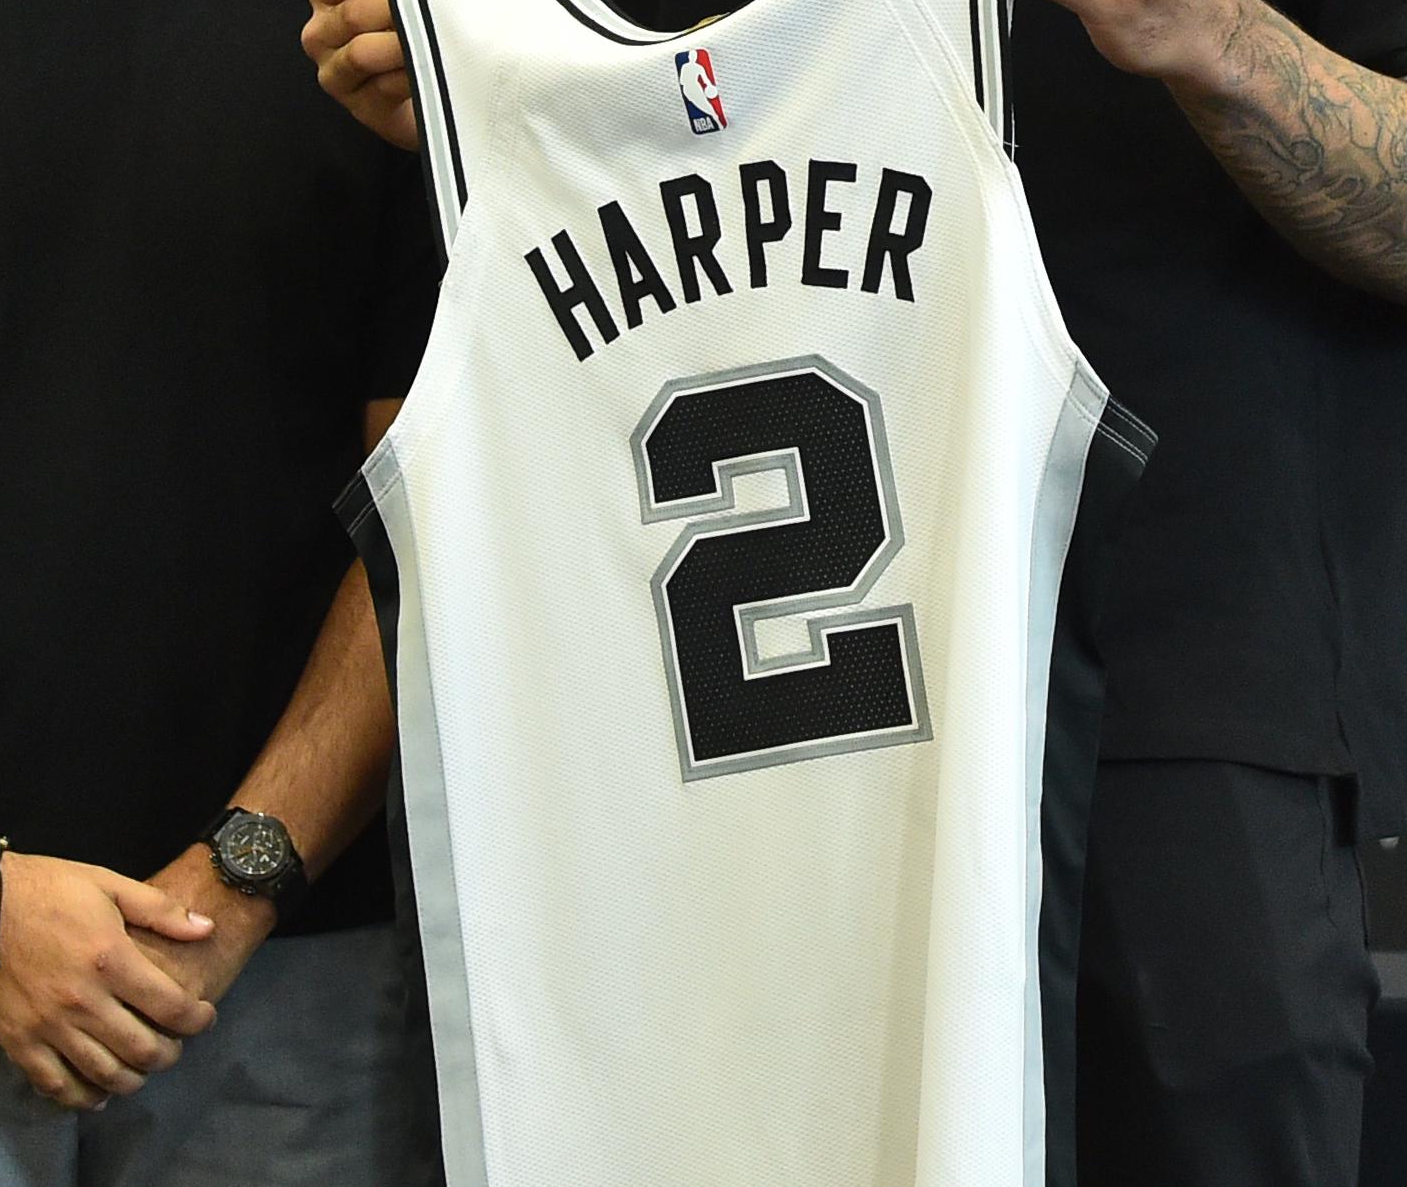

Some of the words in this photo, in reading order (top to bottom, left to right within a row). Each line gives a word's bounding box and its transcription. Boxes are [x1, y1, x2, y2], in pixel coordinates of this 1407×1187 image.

[693, 116, 714, 133] NBA
[524, 159, 933, 362] HARPER
[629, 353, 934, 783] 2
